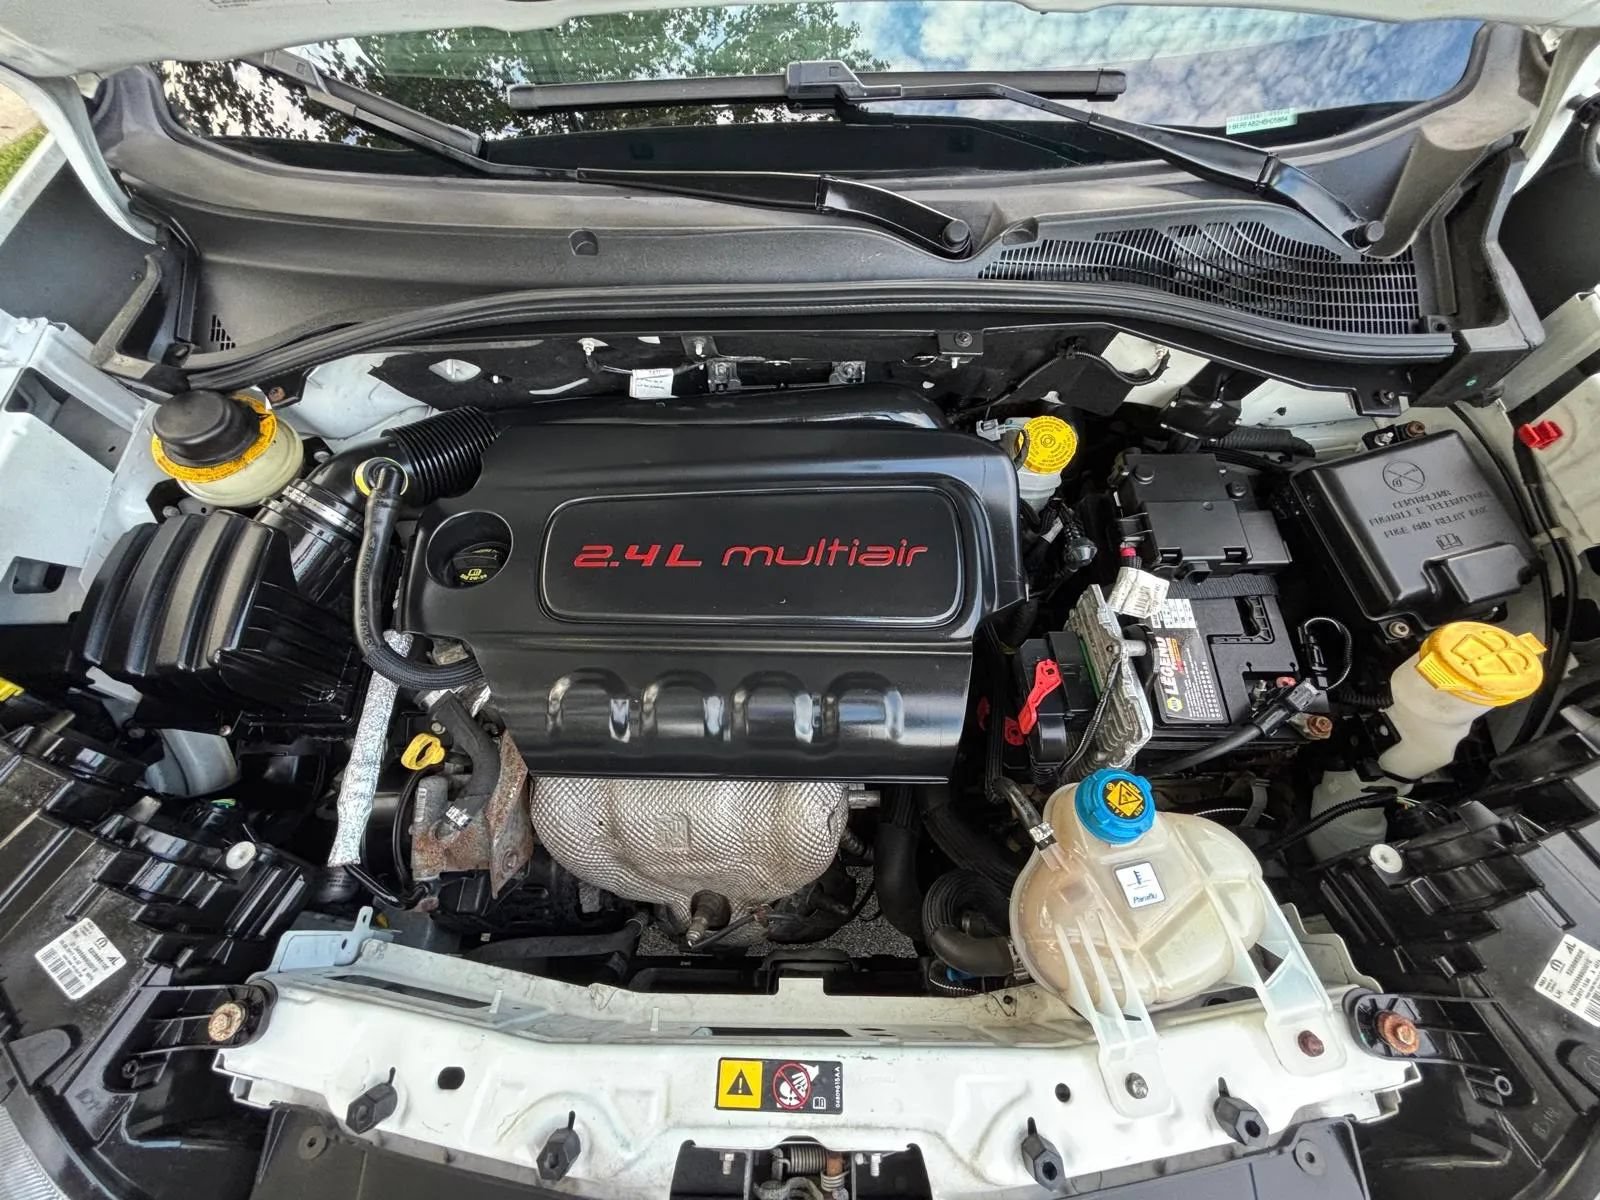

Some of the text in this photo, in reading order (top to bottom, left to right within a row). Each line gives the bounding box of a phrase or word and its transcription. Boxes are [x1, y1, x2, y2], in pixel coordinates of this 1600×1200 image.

[573, 537, 928, 568] 2.4L multiair
[1155, 636, 1179, 695] LEGEND
